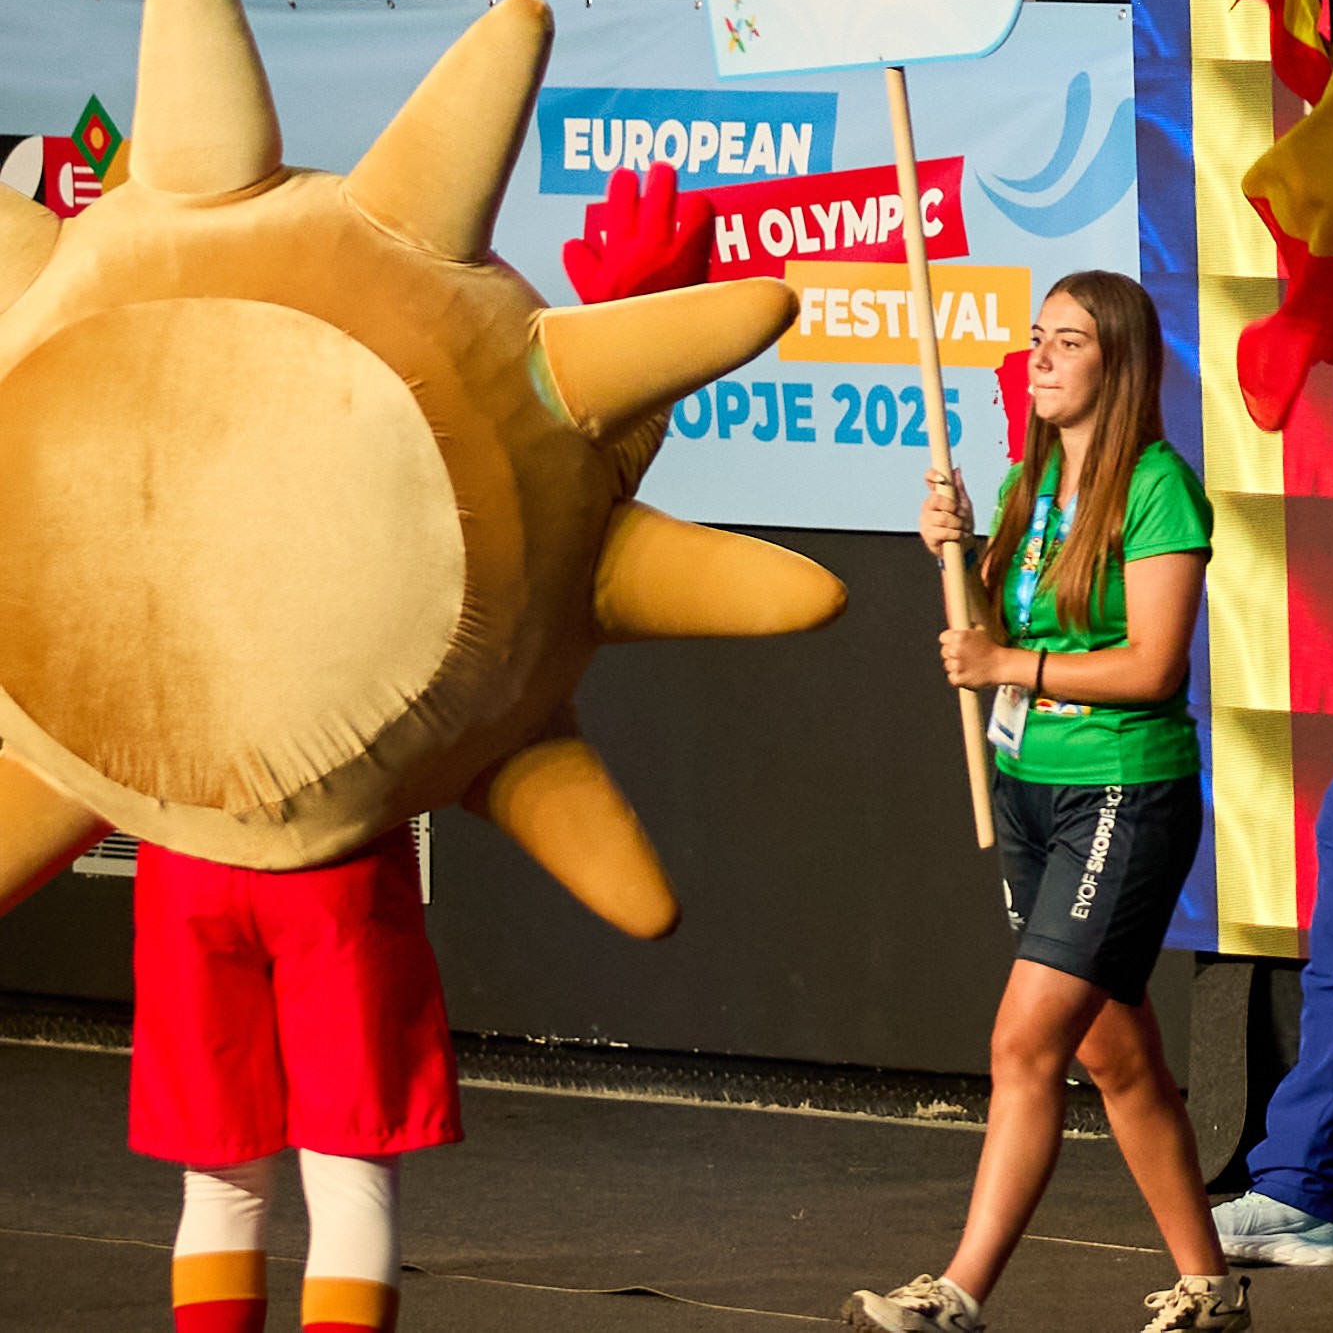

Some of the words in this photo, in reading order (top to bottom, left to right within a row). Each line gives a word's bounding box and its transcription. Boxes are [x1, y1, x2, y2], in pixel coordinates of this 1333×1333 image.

[563, 117, 813, 175] EUROPEAN
[758, 187, 944, 257] OLYMPC
[665, 380, 817, 443] OPJE
[1070, 872, 1099, 920] EYOF
[1086, 807, 1117, 874] SKOPJE
